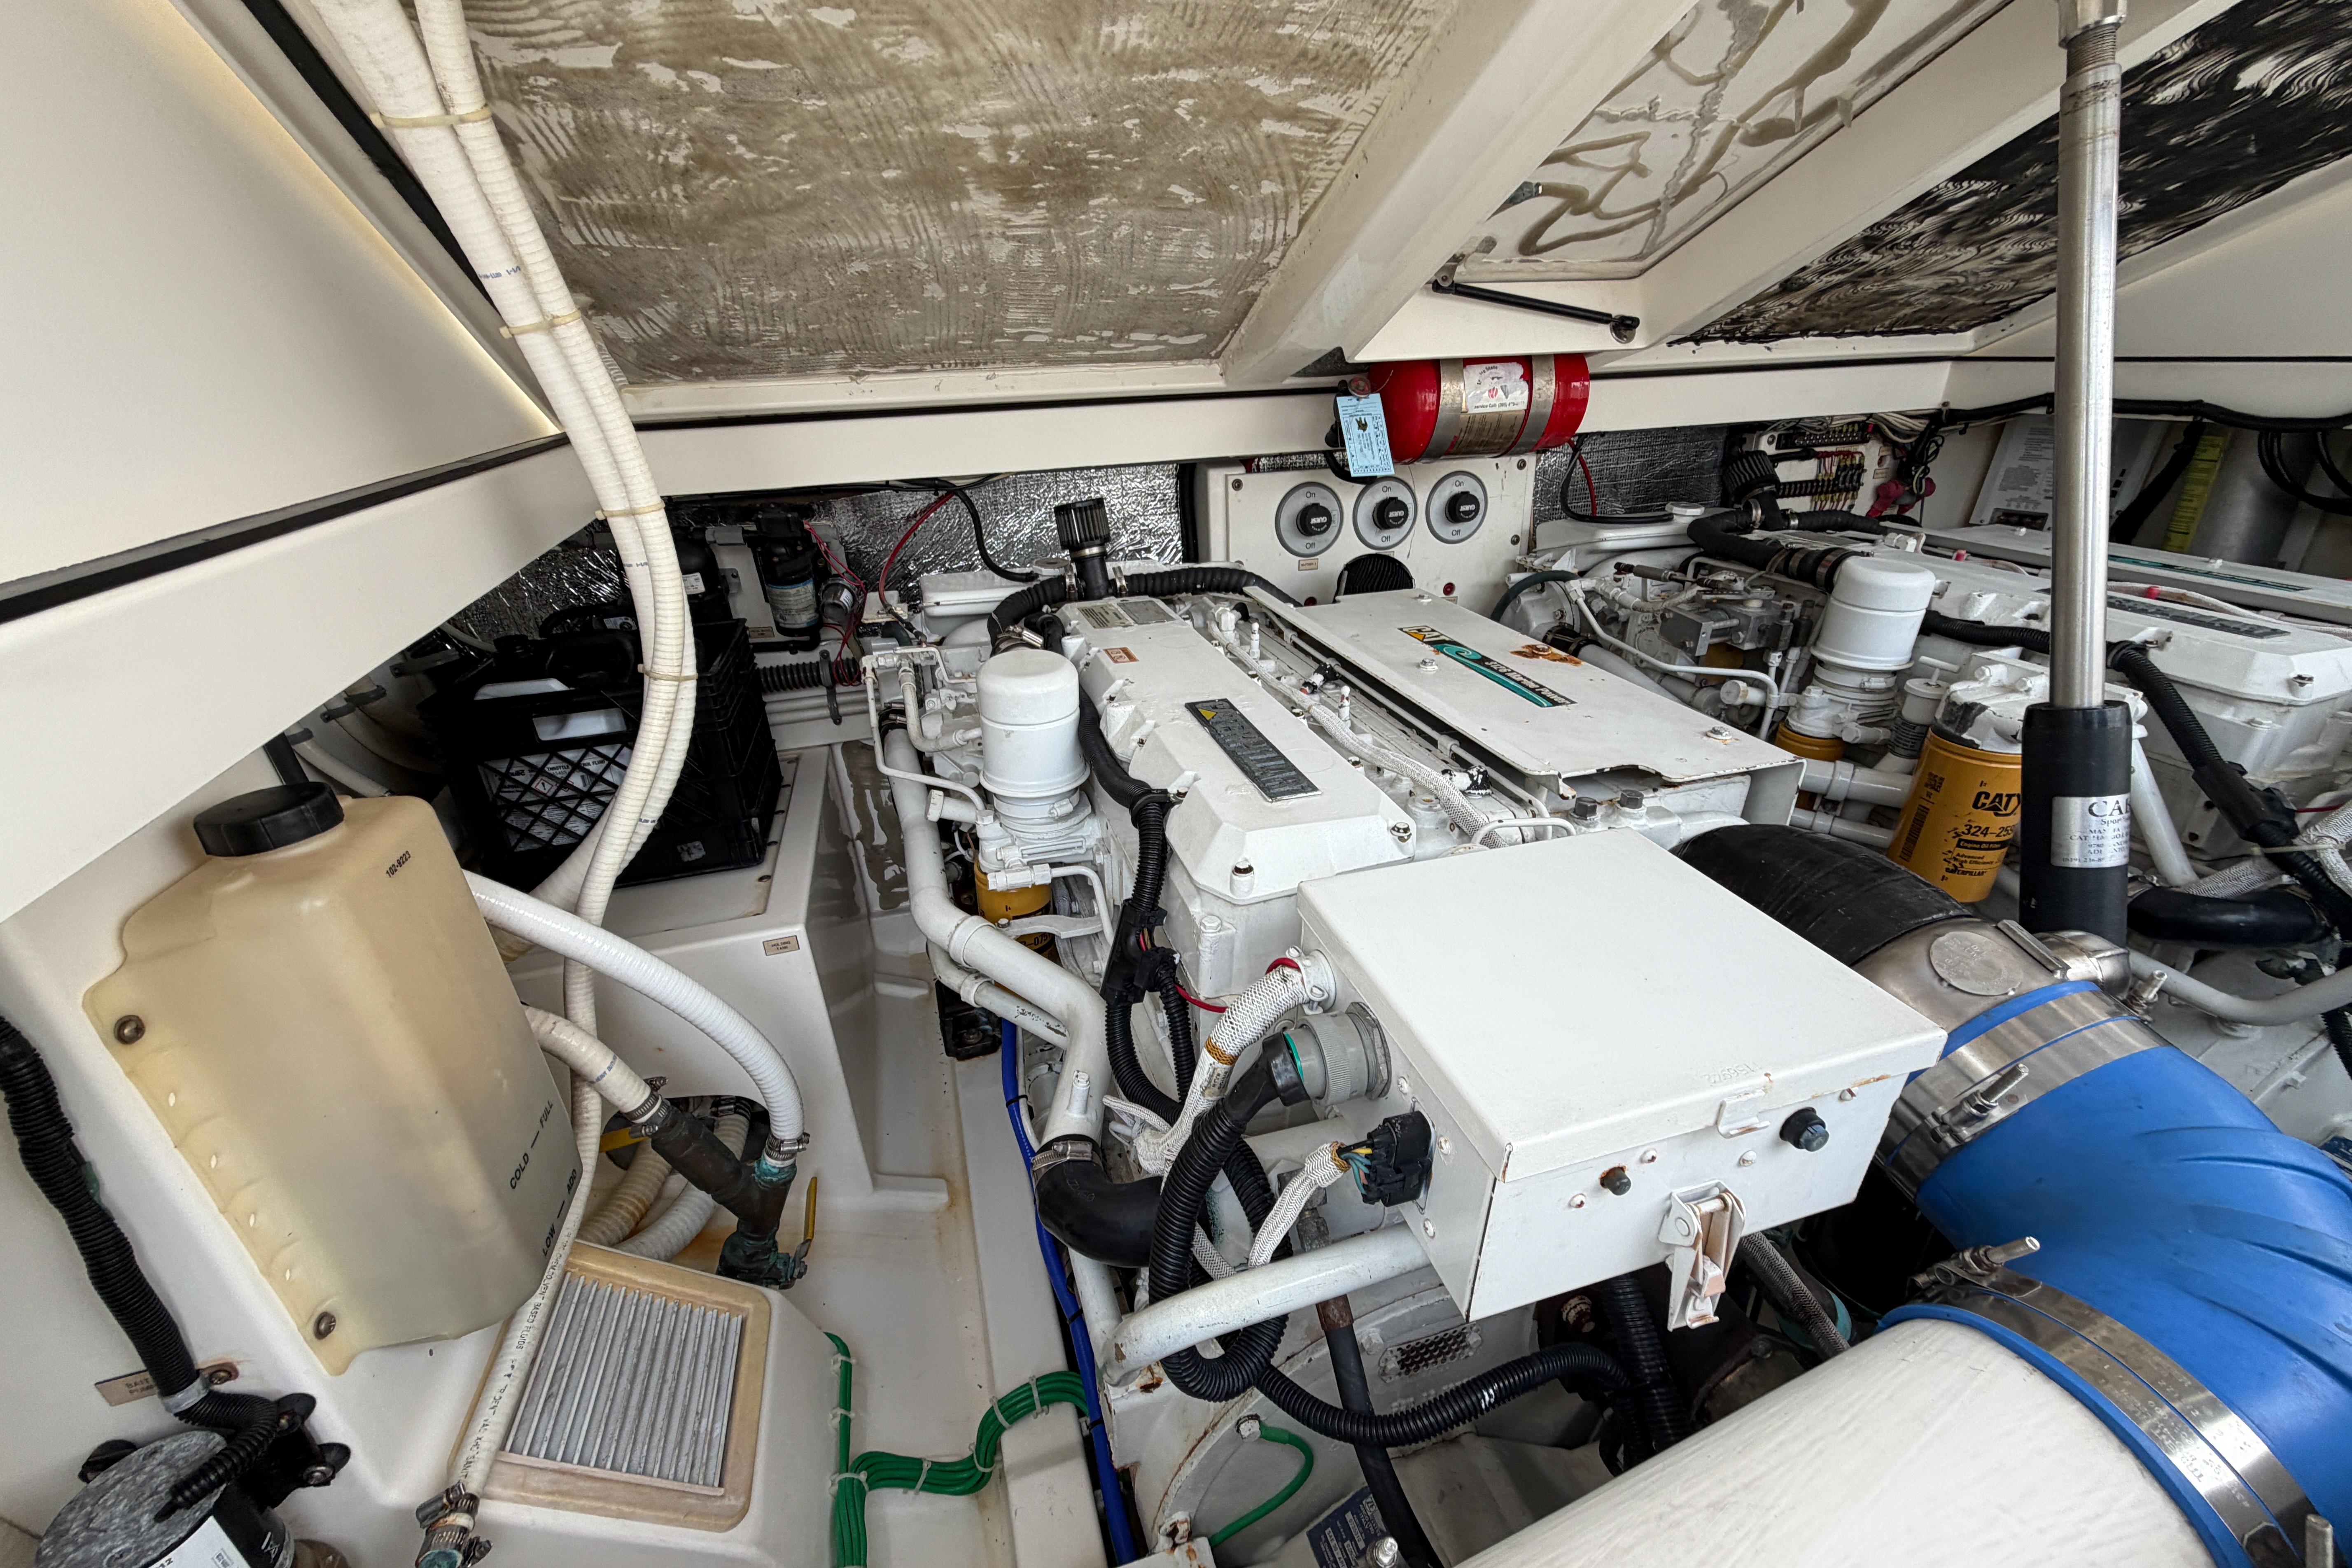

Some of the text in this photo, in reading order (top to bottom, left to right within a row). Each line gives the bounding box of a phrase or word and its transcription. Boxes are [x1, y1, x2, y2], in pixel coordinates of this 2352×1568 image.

[1402, 626, 1453, 642] CAT
[1508, 671, 1541, 689] Marine
[1536, 688, 1571, 704] Power
[1972, 791, 2017, 812] CAT
[386, 850, 411, 877] 102-9223
[540, 1100, 553, 1128] FULL
[510, 1153, 529, 1190] COLD
[567, 1169, 577, 1195] ADD
[542, 1223, 555, 1257] LOW
